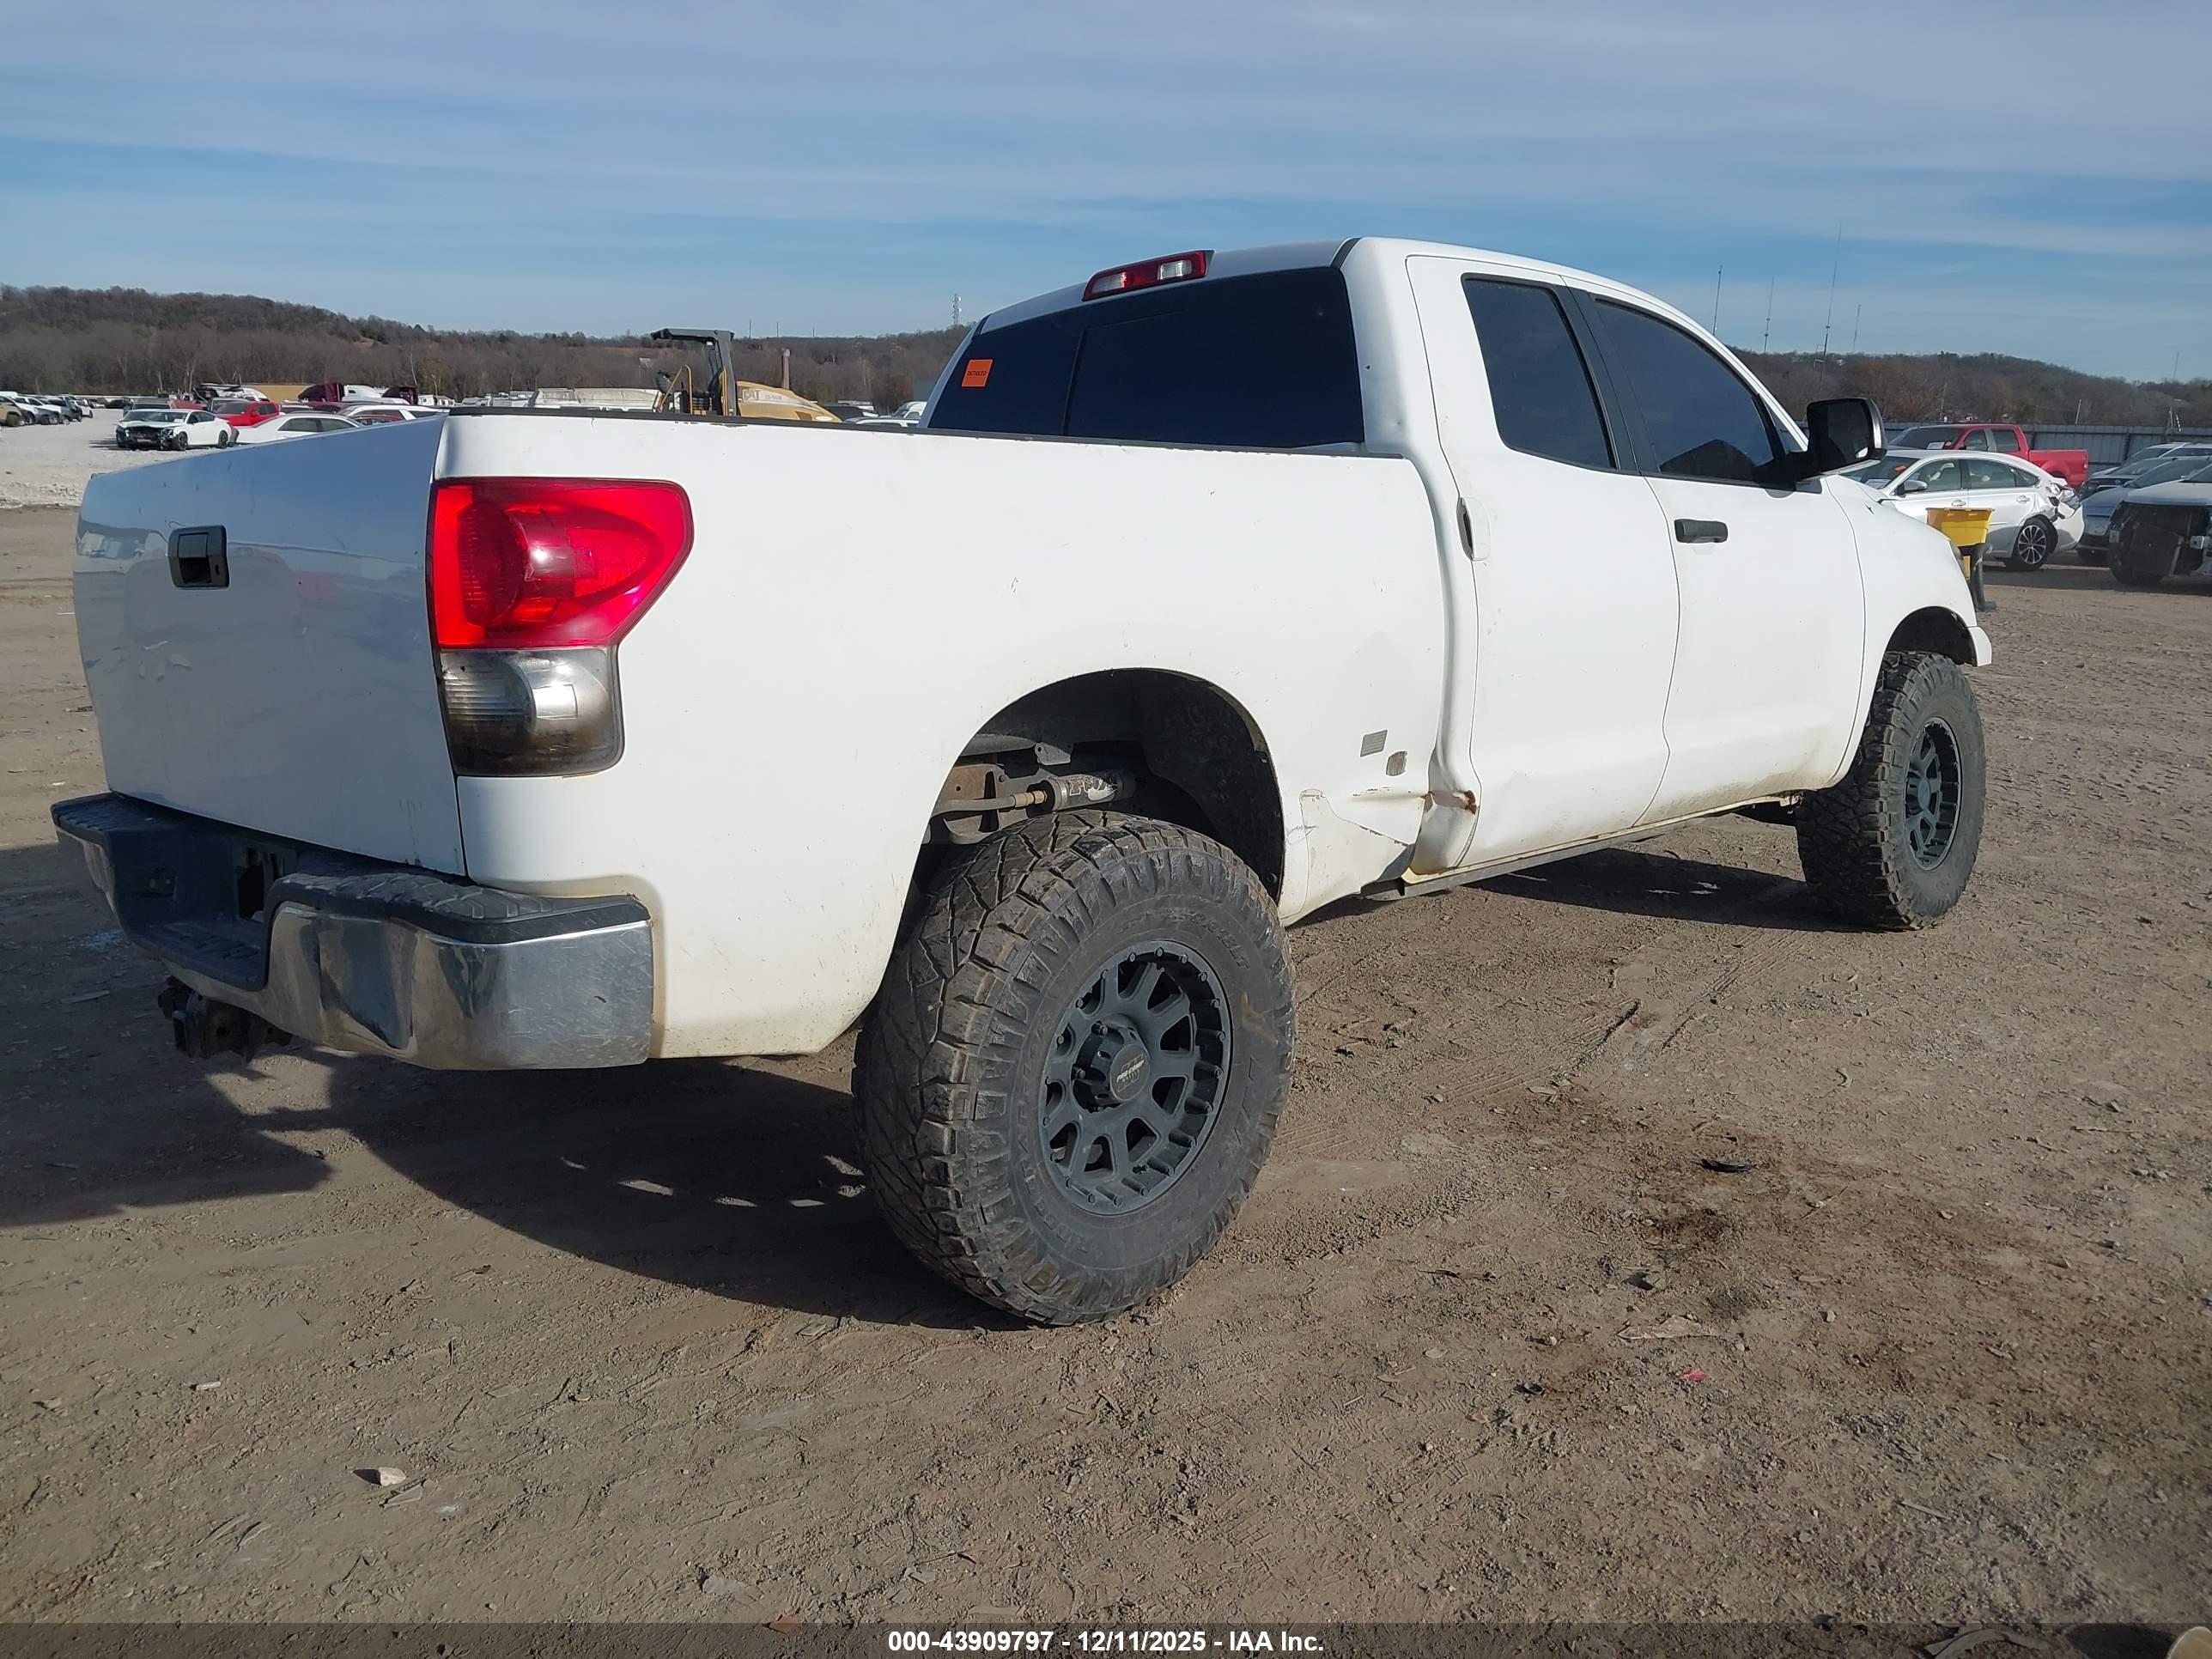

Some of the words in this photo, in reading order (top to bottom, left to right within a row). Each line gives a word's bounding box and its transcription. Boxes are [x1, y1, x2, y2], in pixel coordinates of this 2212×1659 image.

[743, 389, 760, 400] CAT
[1116, 1070, 1127, 1083] PRO
[1128, 1060, 1145, 1074] COMP
